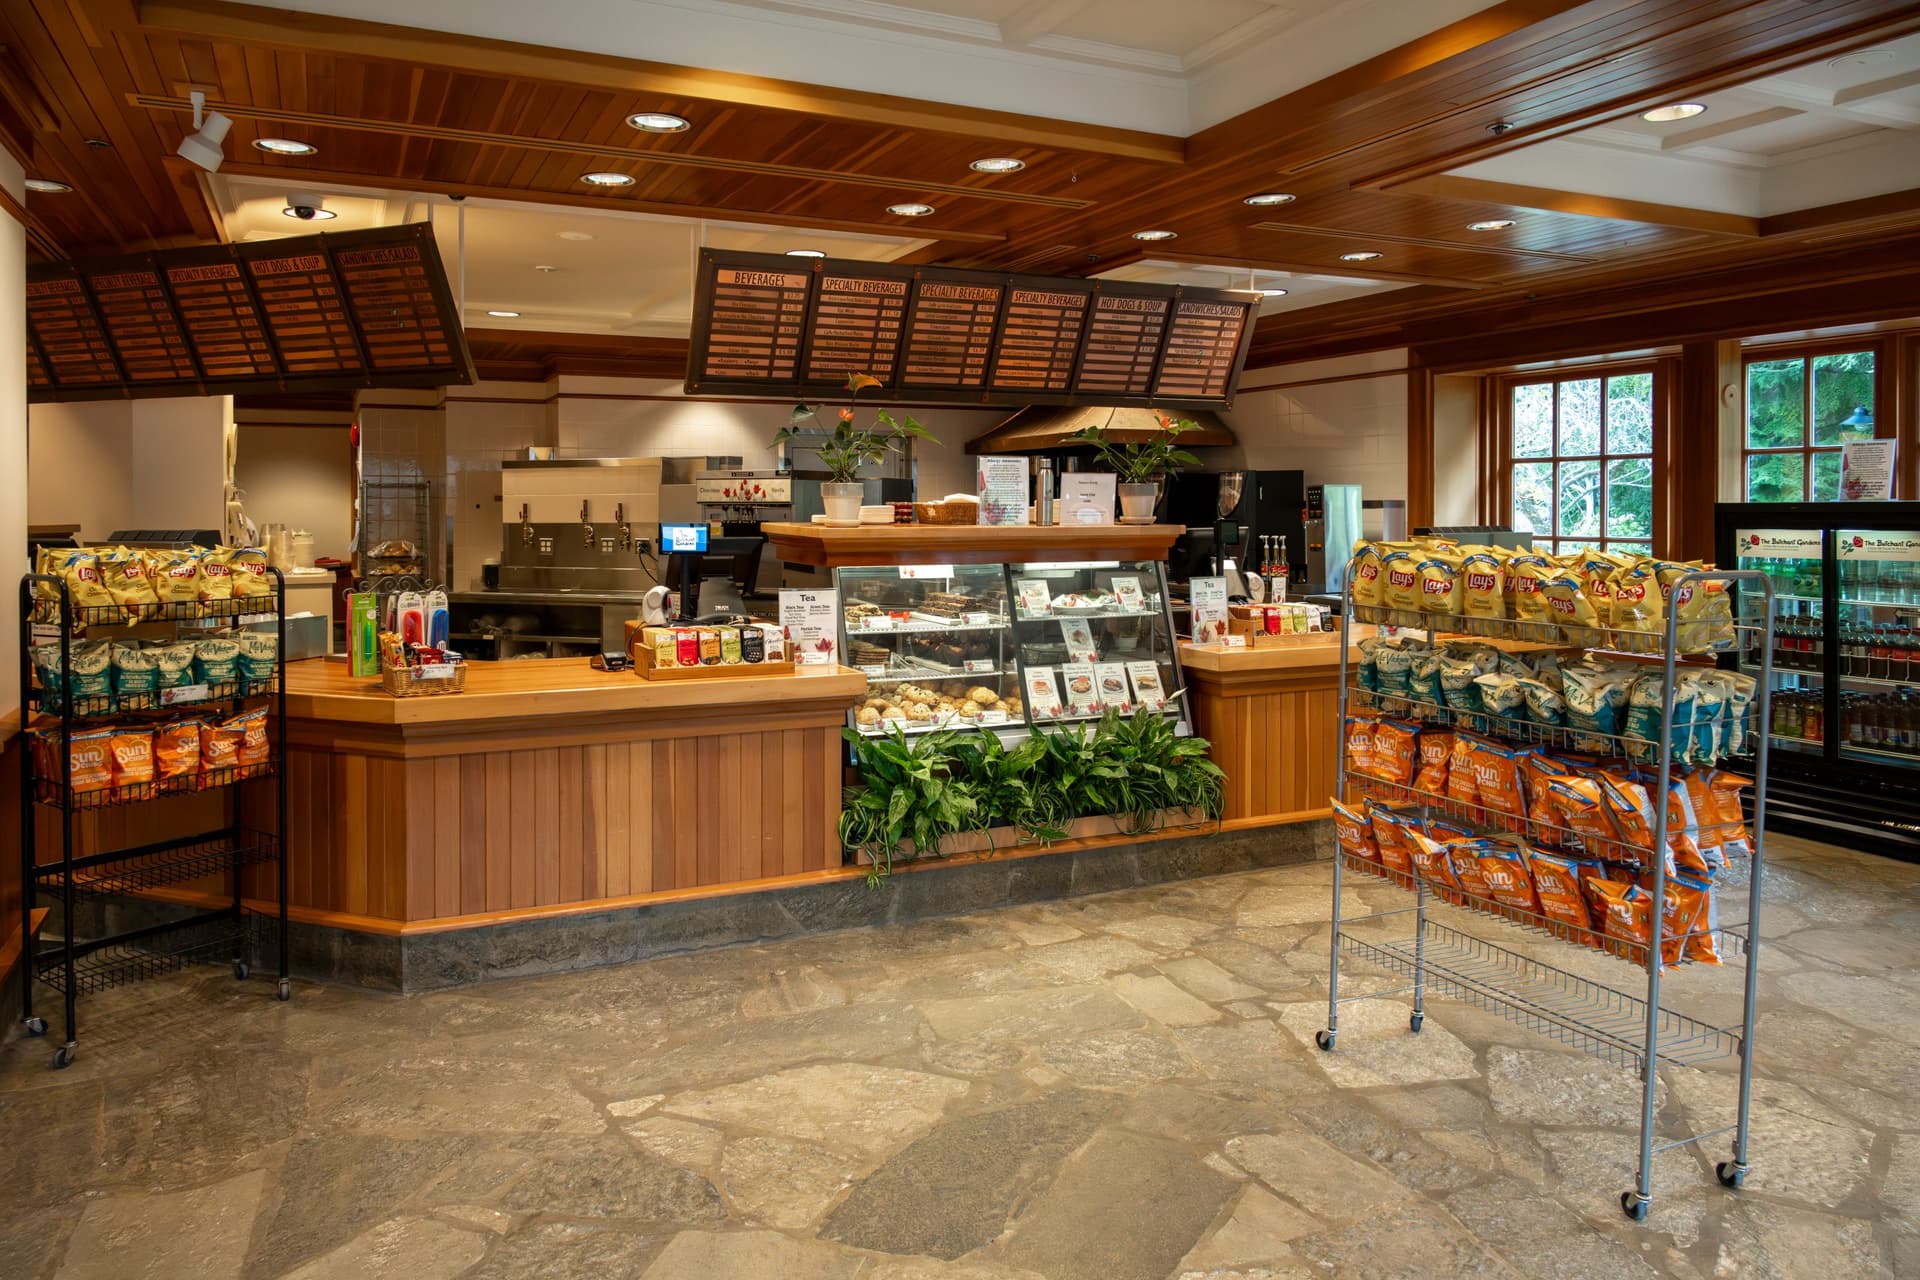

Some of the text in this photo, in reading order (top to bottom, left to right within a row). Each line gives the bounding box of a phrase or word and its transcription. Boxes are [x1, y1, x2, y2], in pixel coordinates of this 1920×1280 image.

[254, 259, 269, 274] HOT
[269, 257, 292, 273] DOGS
[299, 256, 320, 270] SOUP
[734, 272, 785, 287] BEVERAGES
[825, 278, 904, 294] SPECIALTY BEVERAGES
[921, 284, 999, 300] SPECIALTY BEVERAGES
[1014, 291, 1083, 307] SPECIALTY BEVERAGES
[1101, 298, 1116, 309] HOT
[1117, 299, 1136, 310] DOGS
[1143, 301, 1162, 312] SOUP
[799, 594, 816, 602] Tea
[176, 737, 199, 753] Su
[71, 751, 104, 772] Sun
[116, 745, 149, 764] Sun
